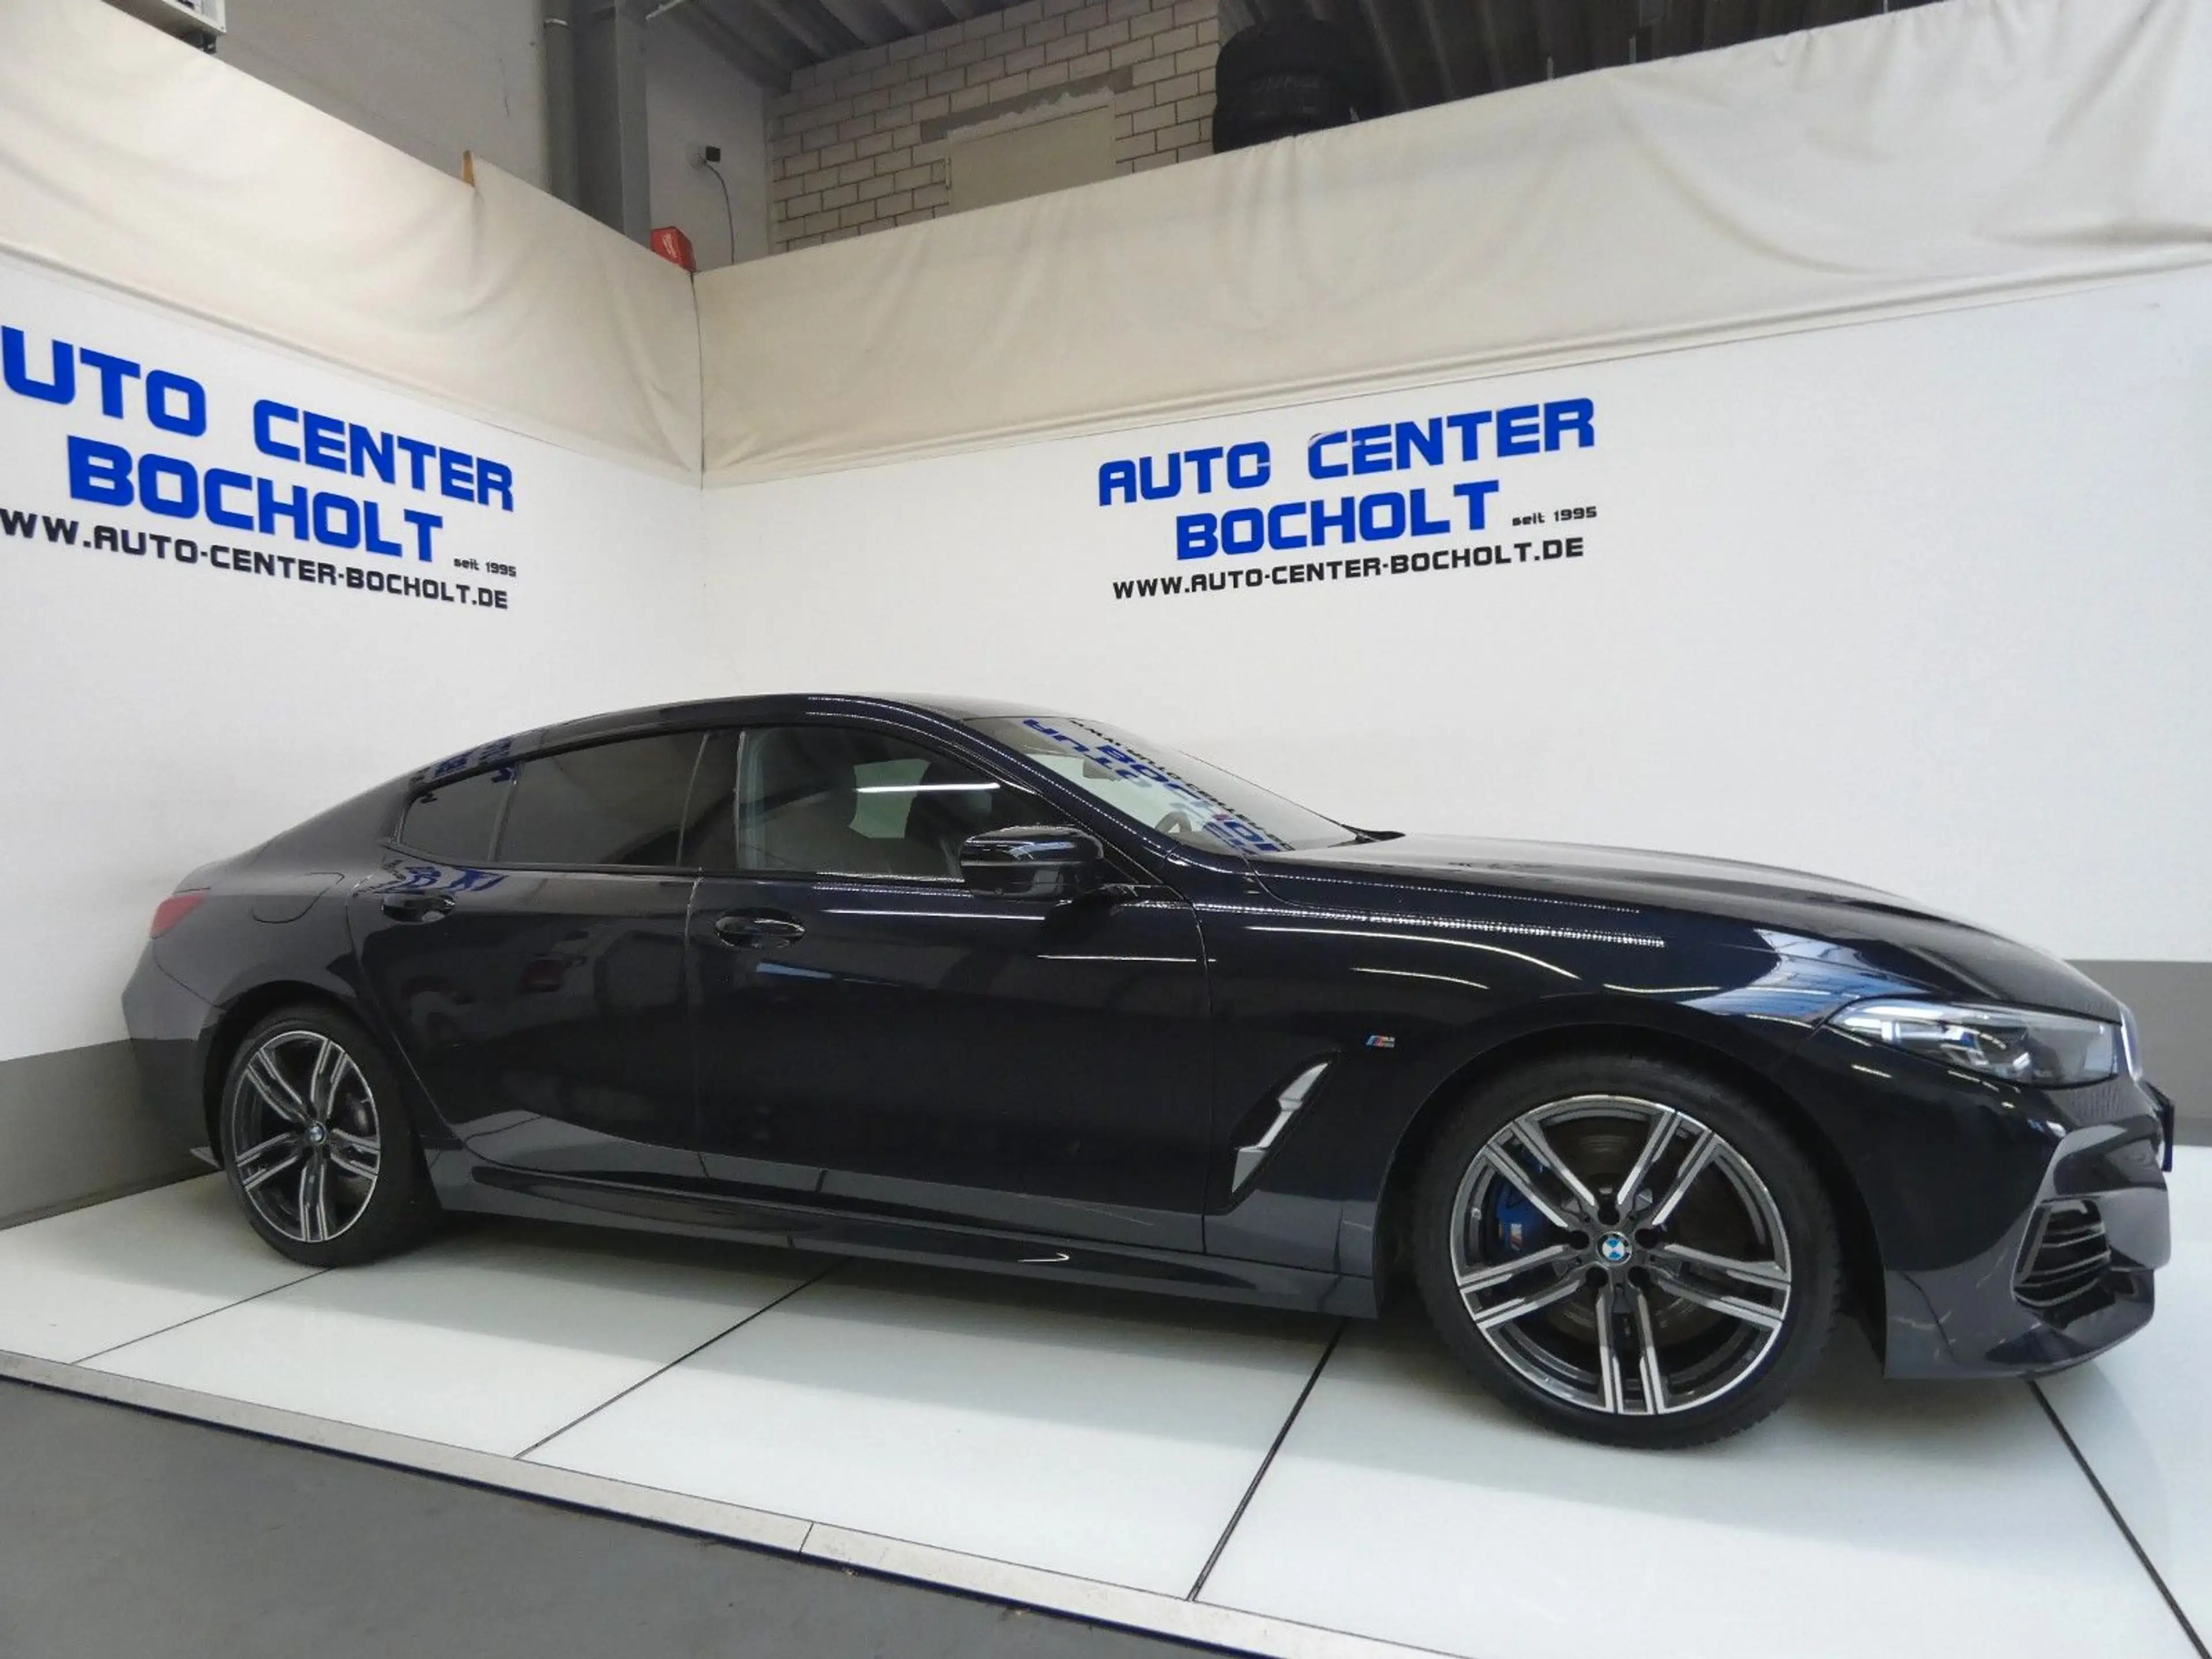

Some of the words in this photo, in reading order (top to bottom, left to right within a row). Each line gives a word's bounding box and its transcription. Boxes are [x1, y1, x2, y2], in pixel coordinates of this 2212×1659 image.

[253, 399, 514, 512] CENTER
[1099, 441, 1271, 507] AUTO
[1308, 397, 1595, 480] CENTER
[67, 435, 444, 563] BOCHOLT
[1176, 479, 1501, 560] BOCHOLT
[1512, 512, 1546, 527] seit
[1554, 506, 1597, 522] 1995
[453, 558, 479, 571] seit
[486, 562, 517, 578] 1995
[1112, 536, 1584, 600] WWW.AUTO-CENTER-BOCHOLT.DE
